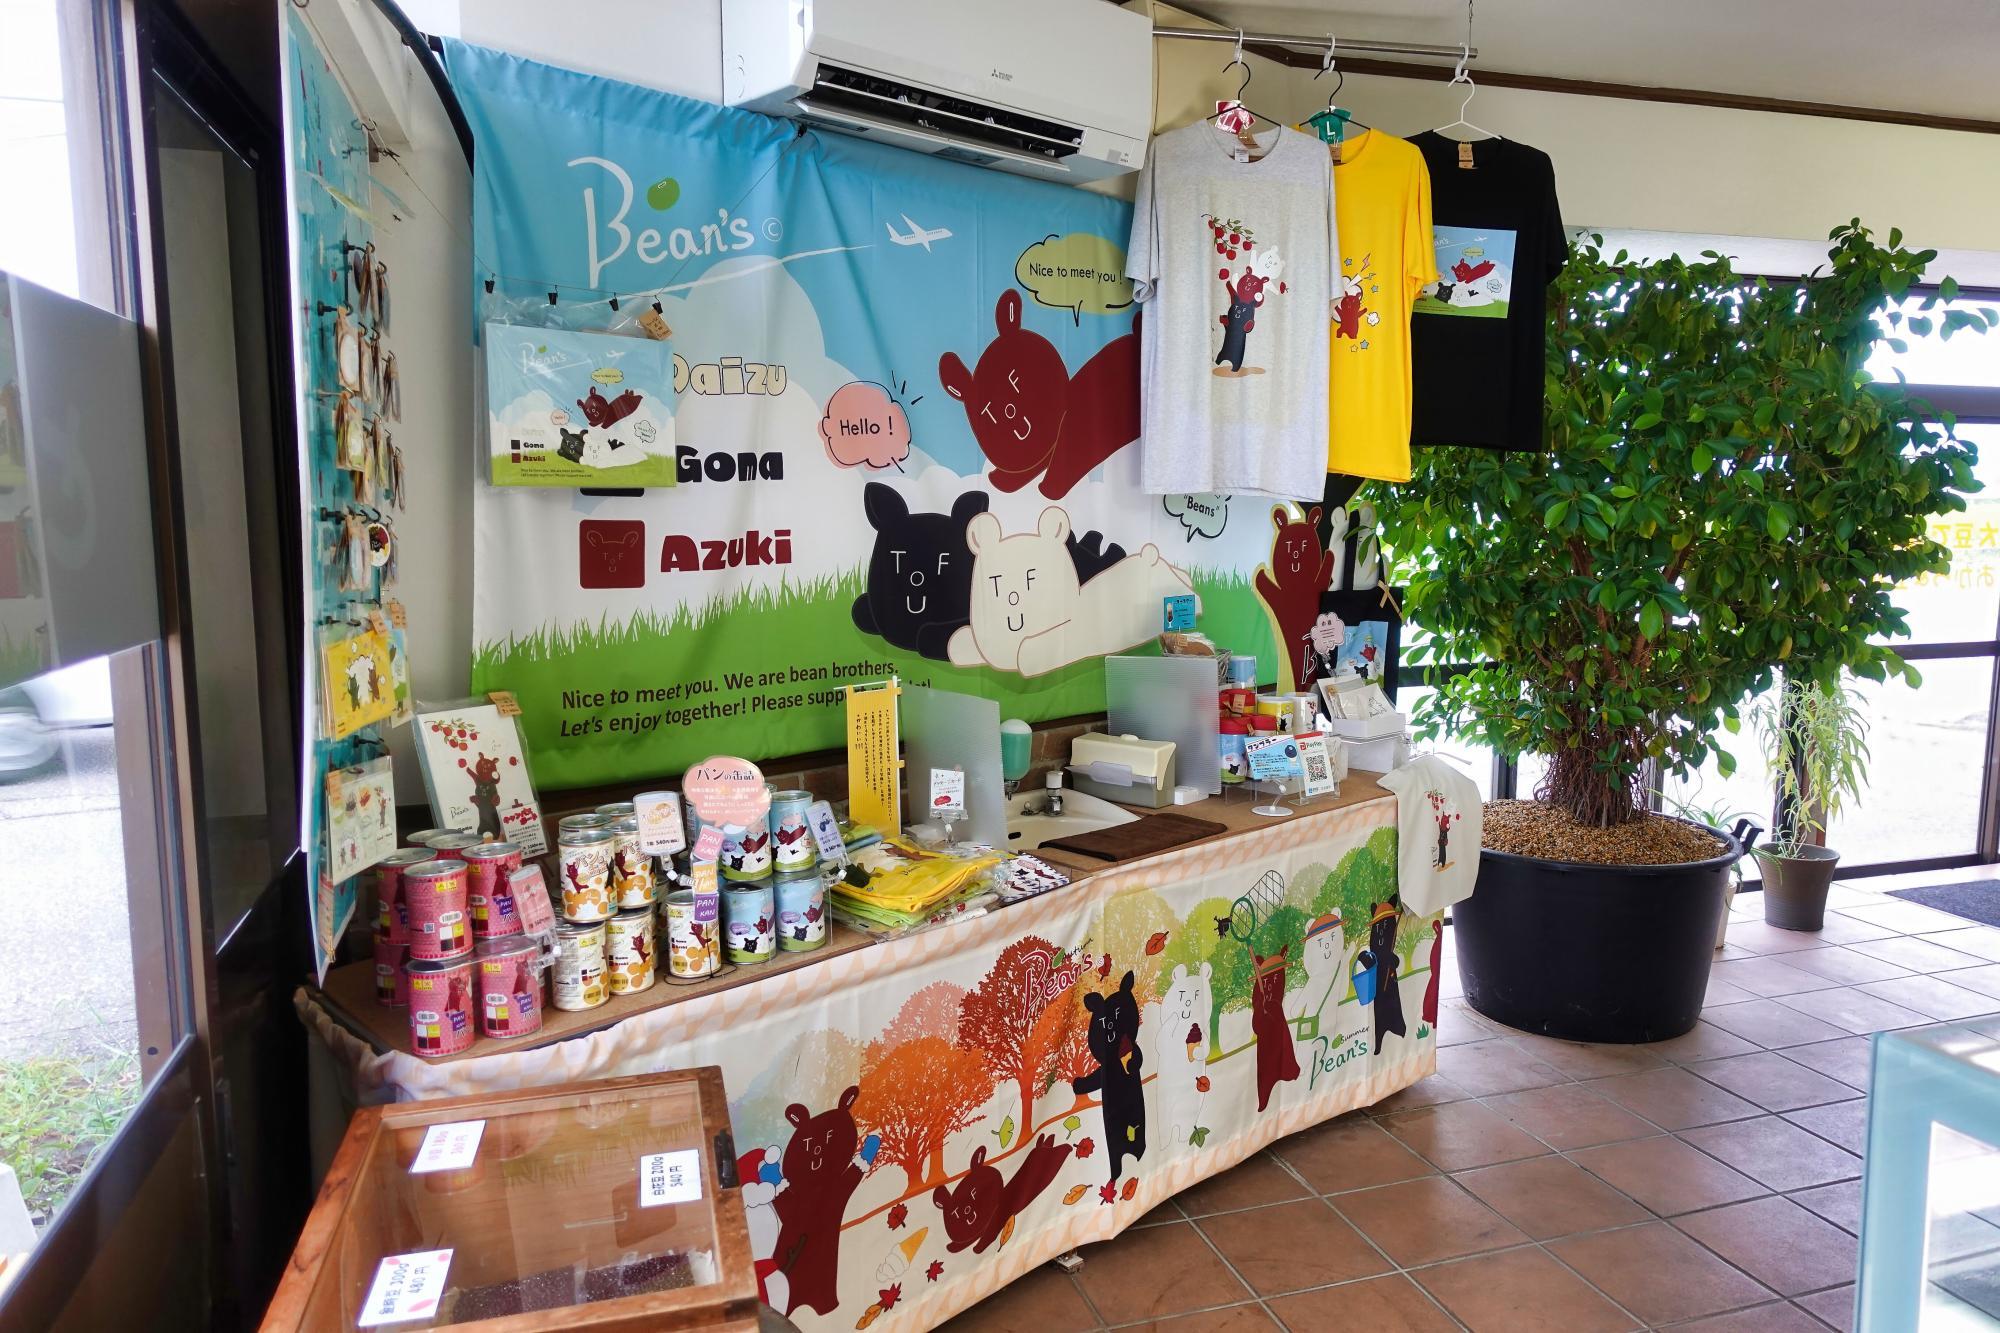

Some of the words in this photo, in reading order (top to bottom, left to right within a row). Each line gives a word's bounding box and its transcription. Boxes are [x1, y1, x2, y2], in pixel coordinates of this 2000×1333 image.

[1326, 121, 1335, 136] L
[568, 156, 755, 289] Bean's
[1029, 263, 1053, 277] Nice
[1057, 266, 1068, 278] to
[1070, 266, 1094, 279] meet
[1097, 270, 1116, 283] you
[839, 418, 881, 437] Hello
[523, 441, 545, 450] Goma
[523, 454, 547, 462] Azuki
[676, 444, 785, 483] Goma
[660, 529, 793, 573] Azuki
[562, 688, 605, 710] Nice
[611, 688, 630, 706] to
[635, 683, 682, 704] meet
[685, 676, 719, 700] you.
[723, 671, 755, 692] We
[759, 671, 786, 690] are
[789, 662, 828, 682] bean
[831, 658, 899, 679] brothers.
[560, 715, 603, 738] Let's
[608, 711, 661, 737] enjoy
[665, 700, 748, 727] together!
[752, 691, 803, 714] Please
[696, 767, 756, 781] パンの缶詰
[701, 833, 721, 847] PAN
[696, 898, 717, 910] PAN
[700, 908, 716, 917] KAN
[1309, 1035, 1368, 1091] Bean's
[650, 1155, 664, 1174] 200g
